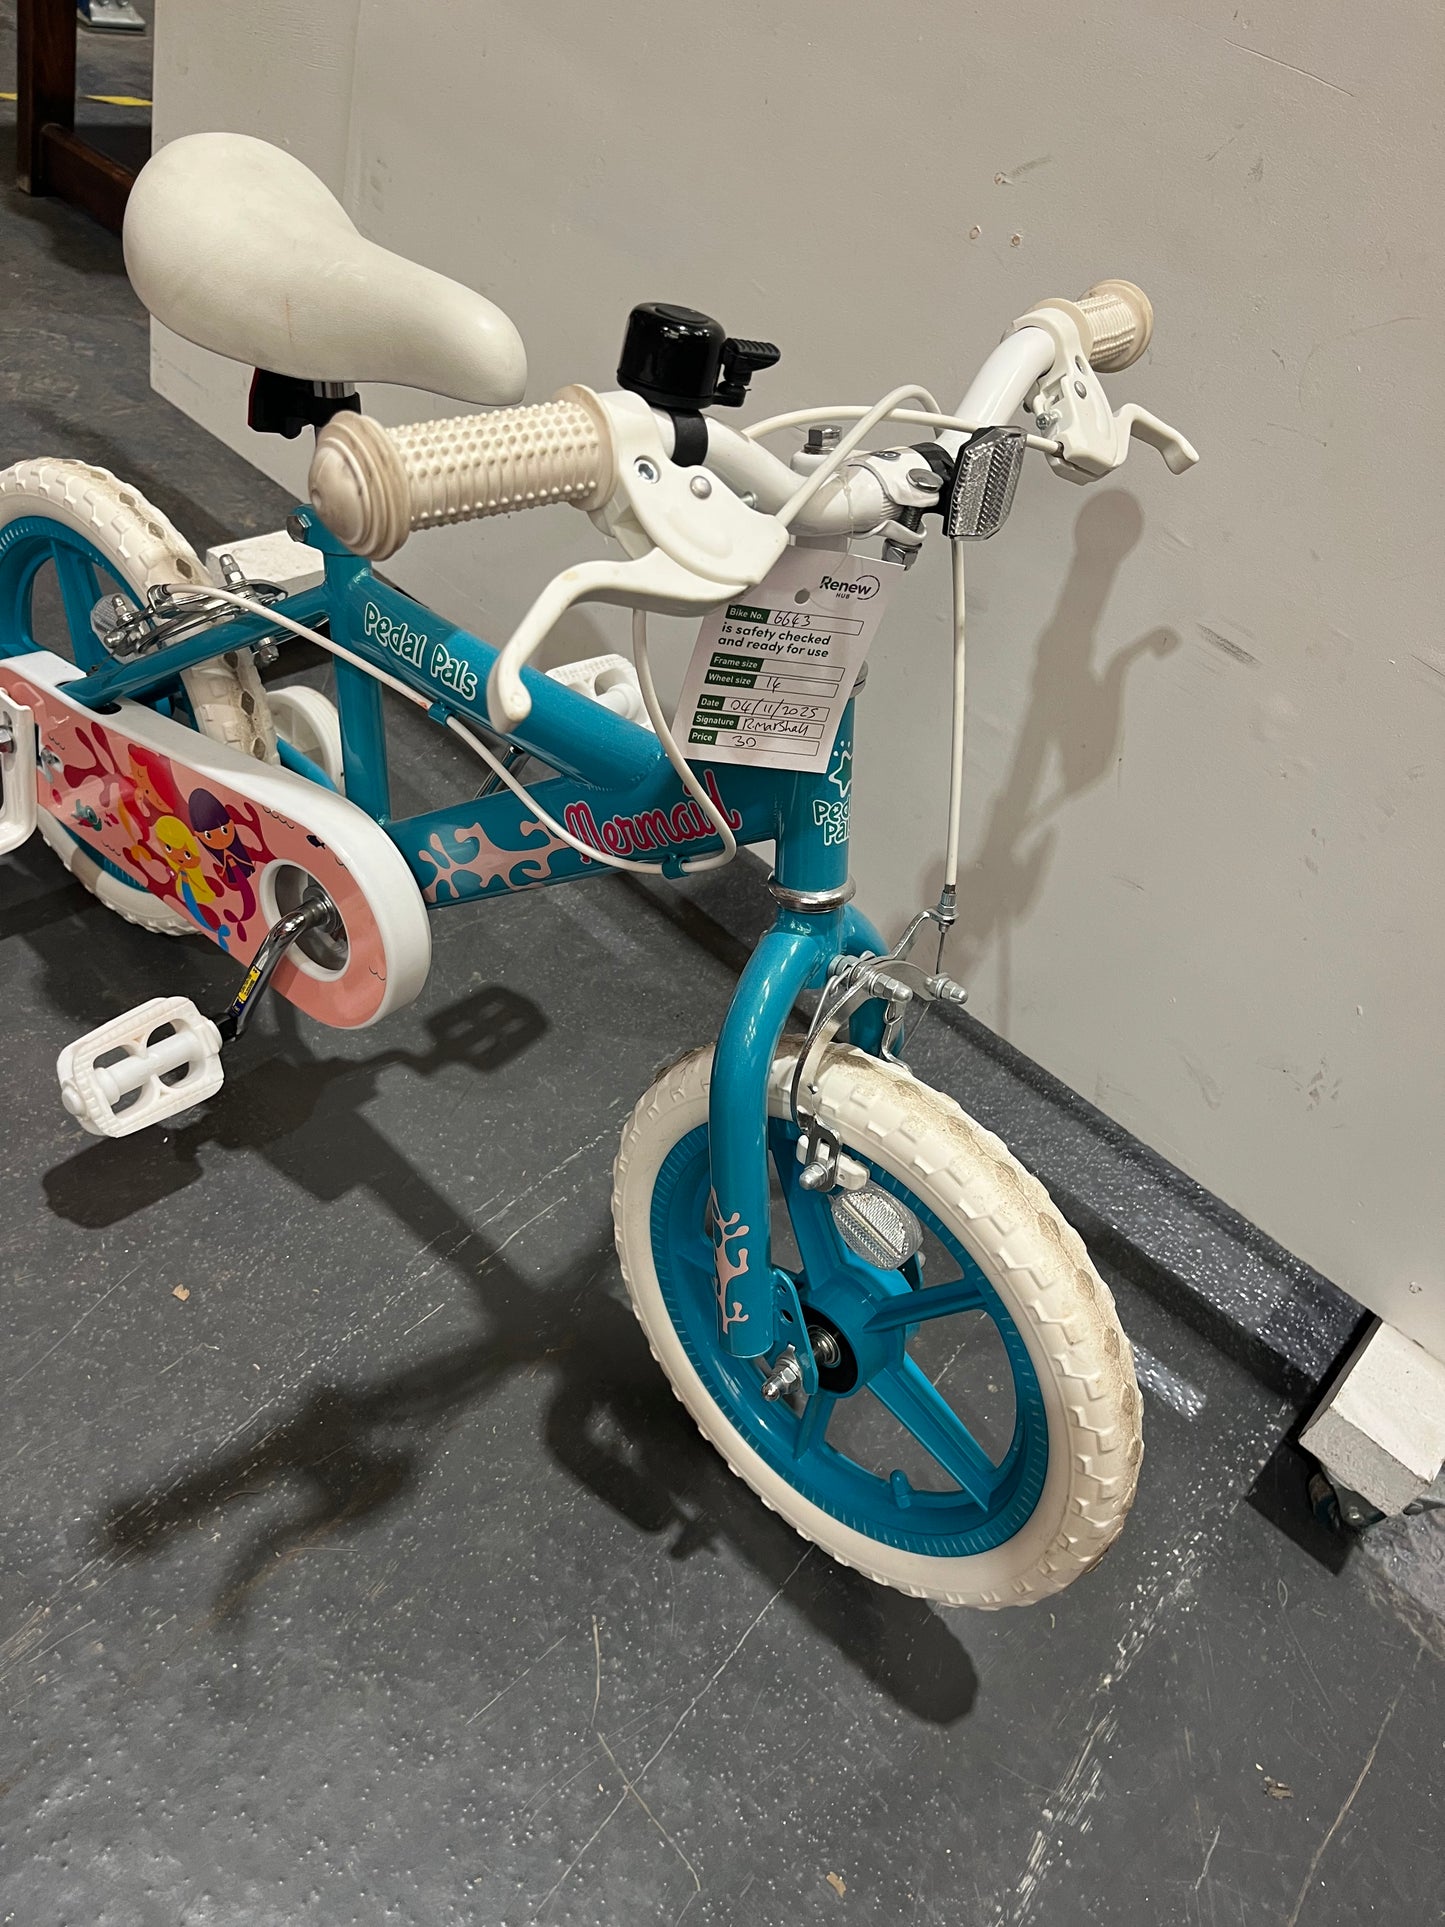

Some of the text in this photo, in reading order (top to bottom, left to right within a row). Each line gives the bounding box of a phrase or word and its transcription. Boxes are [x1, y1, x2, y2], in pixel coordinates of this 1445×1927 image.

[820, 576, 872, 595] Renew
[729, 607, 764, 620] Bike No.
[721, 622, 831, 645] is safety checked
[364, 602, 478, 701] Pedal Pals
[718, 636, 829, 658] and ready for use
[713, 656, 758, 669] Frame size
[708, 672, 752, 686] Wheel size
[701, 697, 720, 707] Date
[730, 698, 819, 720] 04/11/2025
[695, 714, 735, 728] Signature
[691, 731, 713, 742] Price
[732, 735, 757, 748] 30
[564, 769, 743, 864] Mermaid
